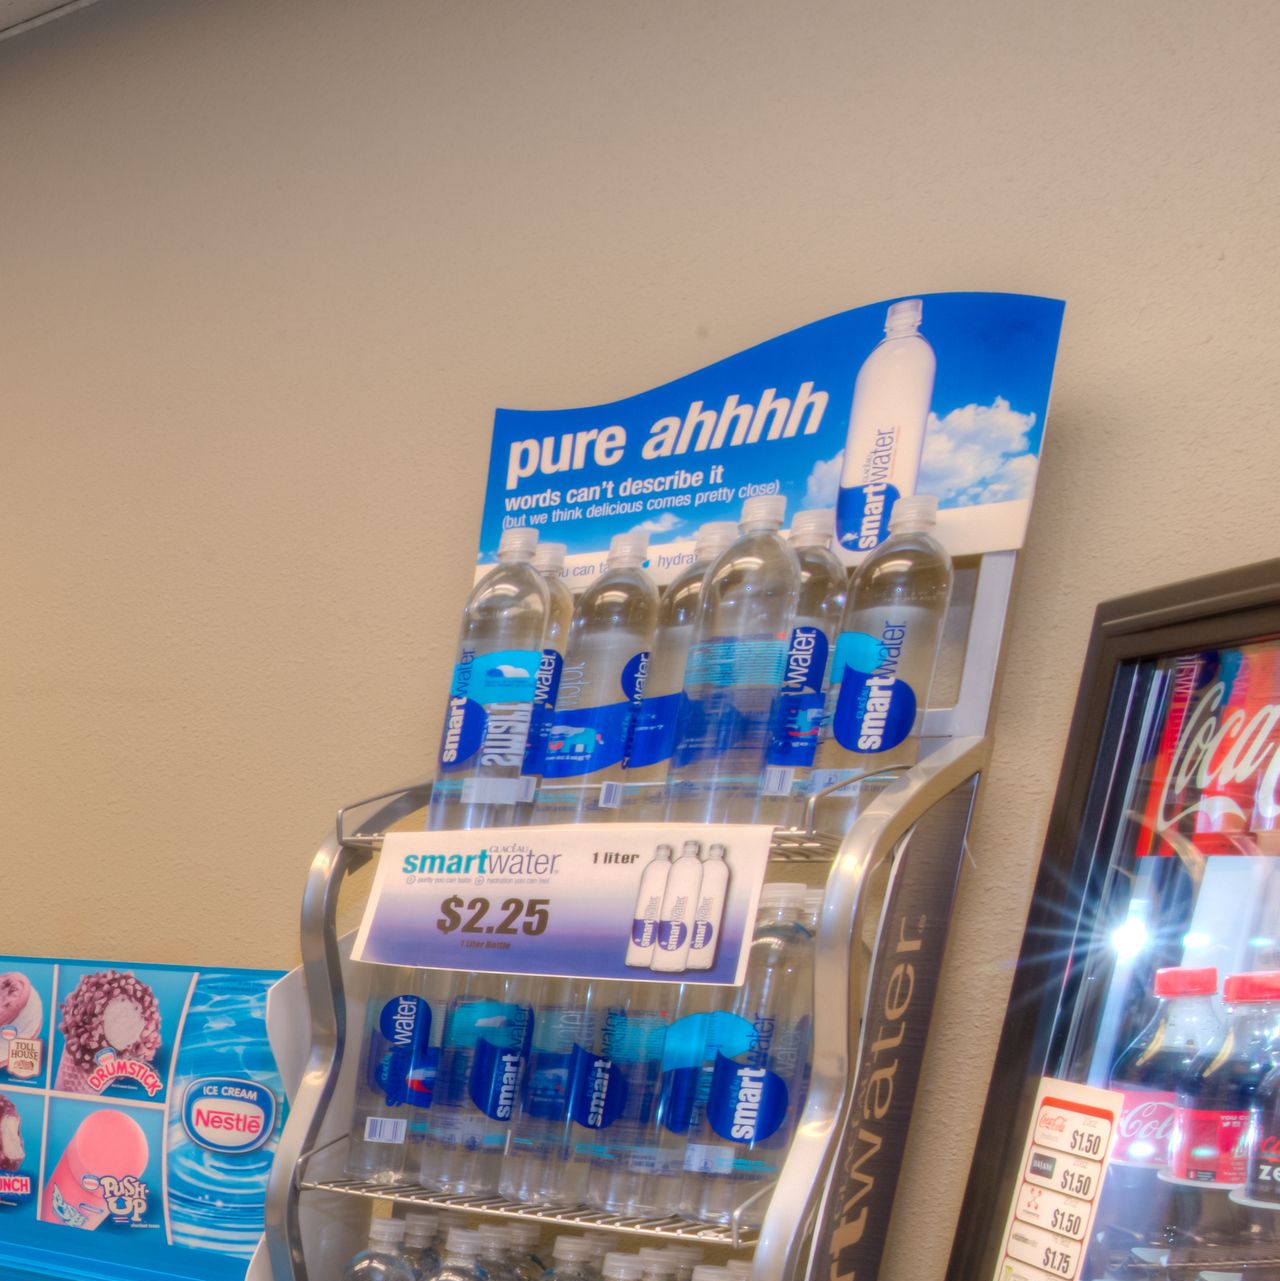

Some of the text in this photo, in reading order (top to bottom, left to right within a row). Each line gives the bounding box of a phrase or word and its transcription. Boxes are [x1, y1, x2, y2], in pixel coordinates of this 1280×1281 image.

[506, 381, 829, 490] pure ahhhh
[505, 465, 724, 512] words can't describe it
[502, 479, 780, 530] (but we think delicious comes pretty close)
[572, 566, 596, 577] can
[657, 552, 697, 570] hydra
[858, 620, 907, 750] smartwater
[402, 849, 639, 875] smartwater 1 liter
[436, 895, 550, 936] $2.25
[10, 1050, 39, 1060] HOUSE
[15, 1041, 35, 1051] TOLL
[89, 1060, 163, 1096] DRUMSTICK
[203, 1086, 258, 1101] ICE CREAM
[1070, 1129, 1101, 1156] $1.50
[1061, 1169, 1091, 1196] $1.50
[106, 1197, 146, 1221] UP
[1051, 1208, 1082, 1235] $1.50
[1042, 1247, 1071, 1274] $1.75
